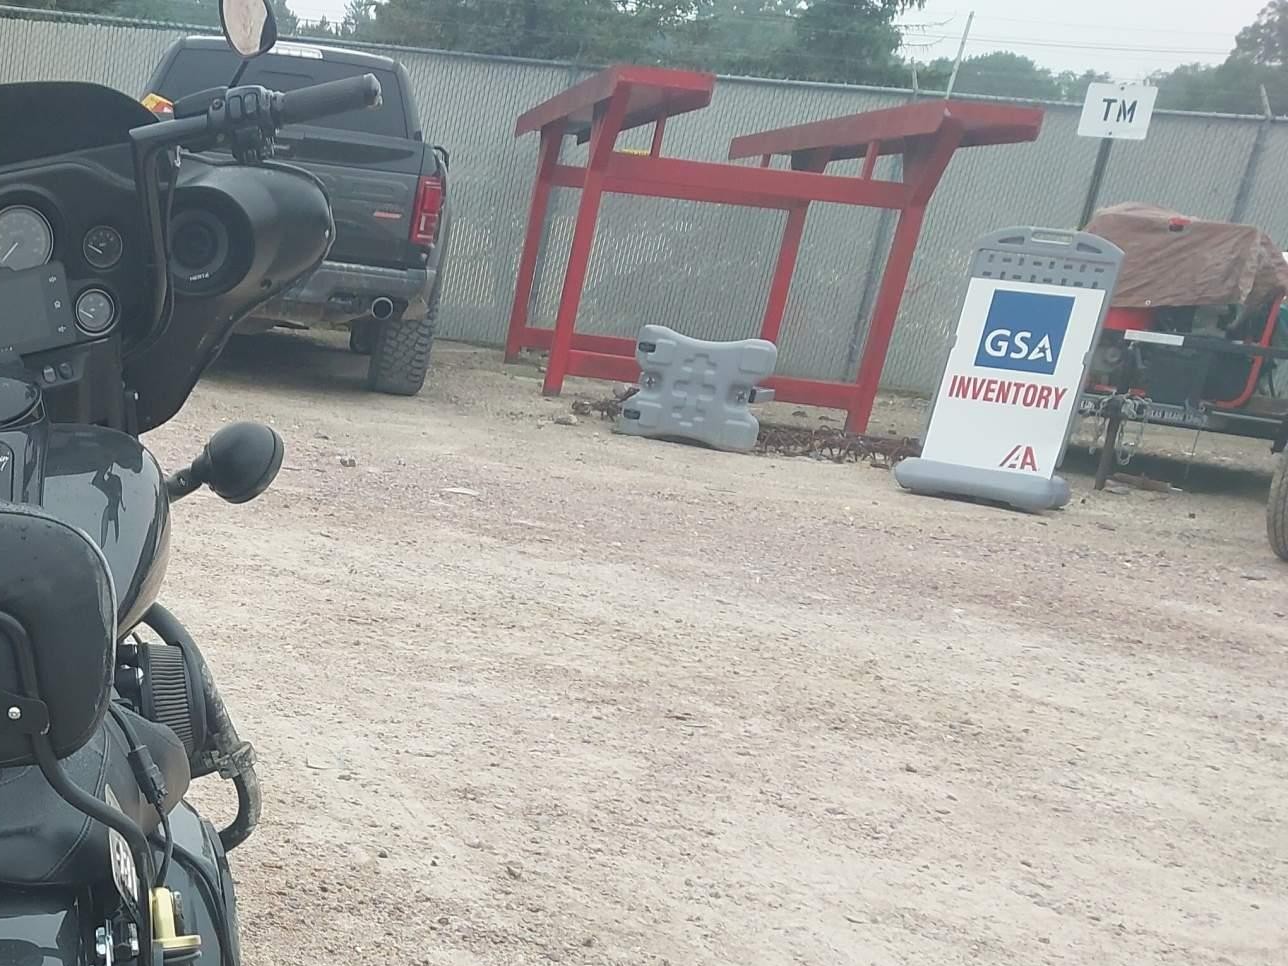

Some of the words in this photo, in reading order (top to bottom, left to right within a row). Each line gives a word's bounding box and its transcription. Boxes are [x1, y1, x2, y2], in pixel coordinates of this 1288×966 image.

[1102, 98, 1137, 122] TM
[984, 328, 1053, 363] GSA
[948, 375, 1068, 411] INVENTORY
